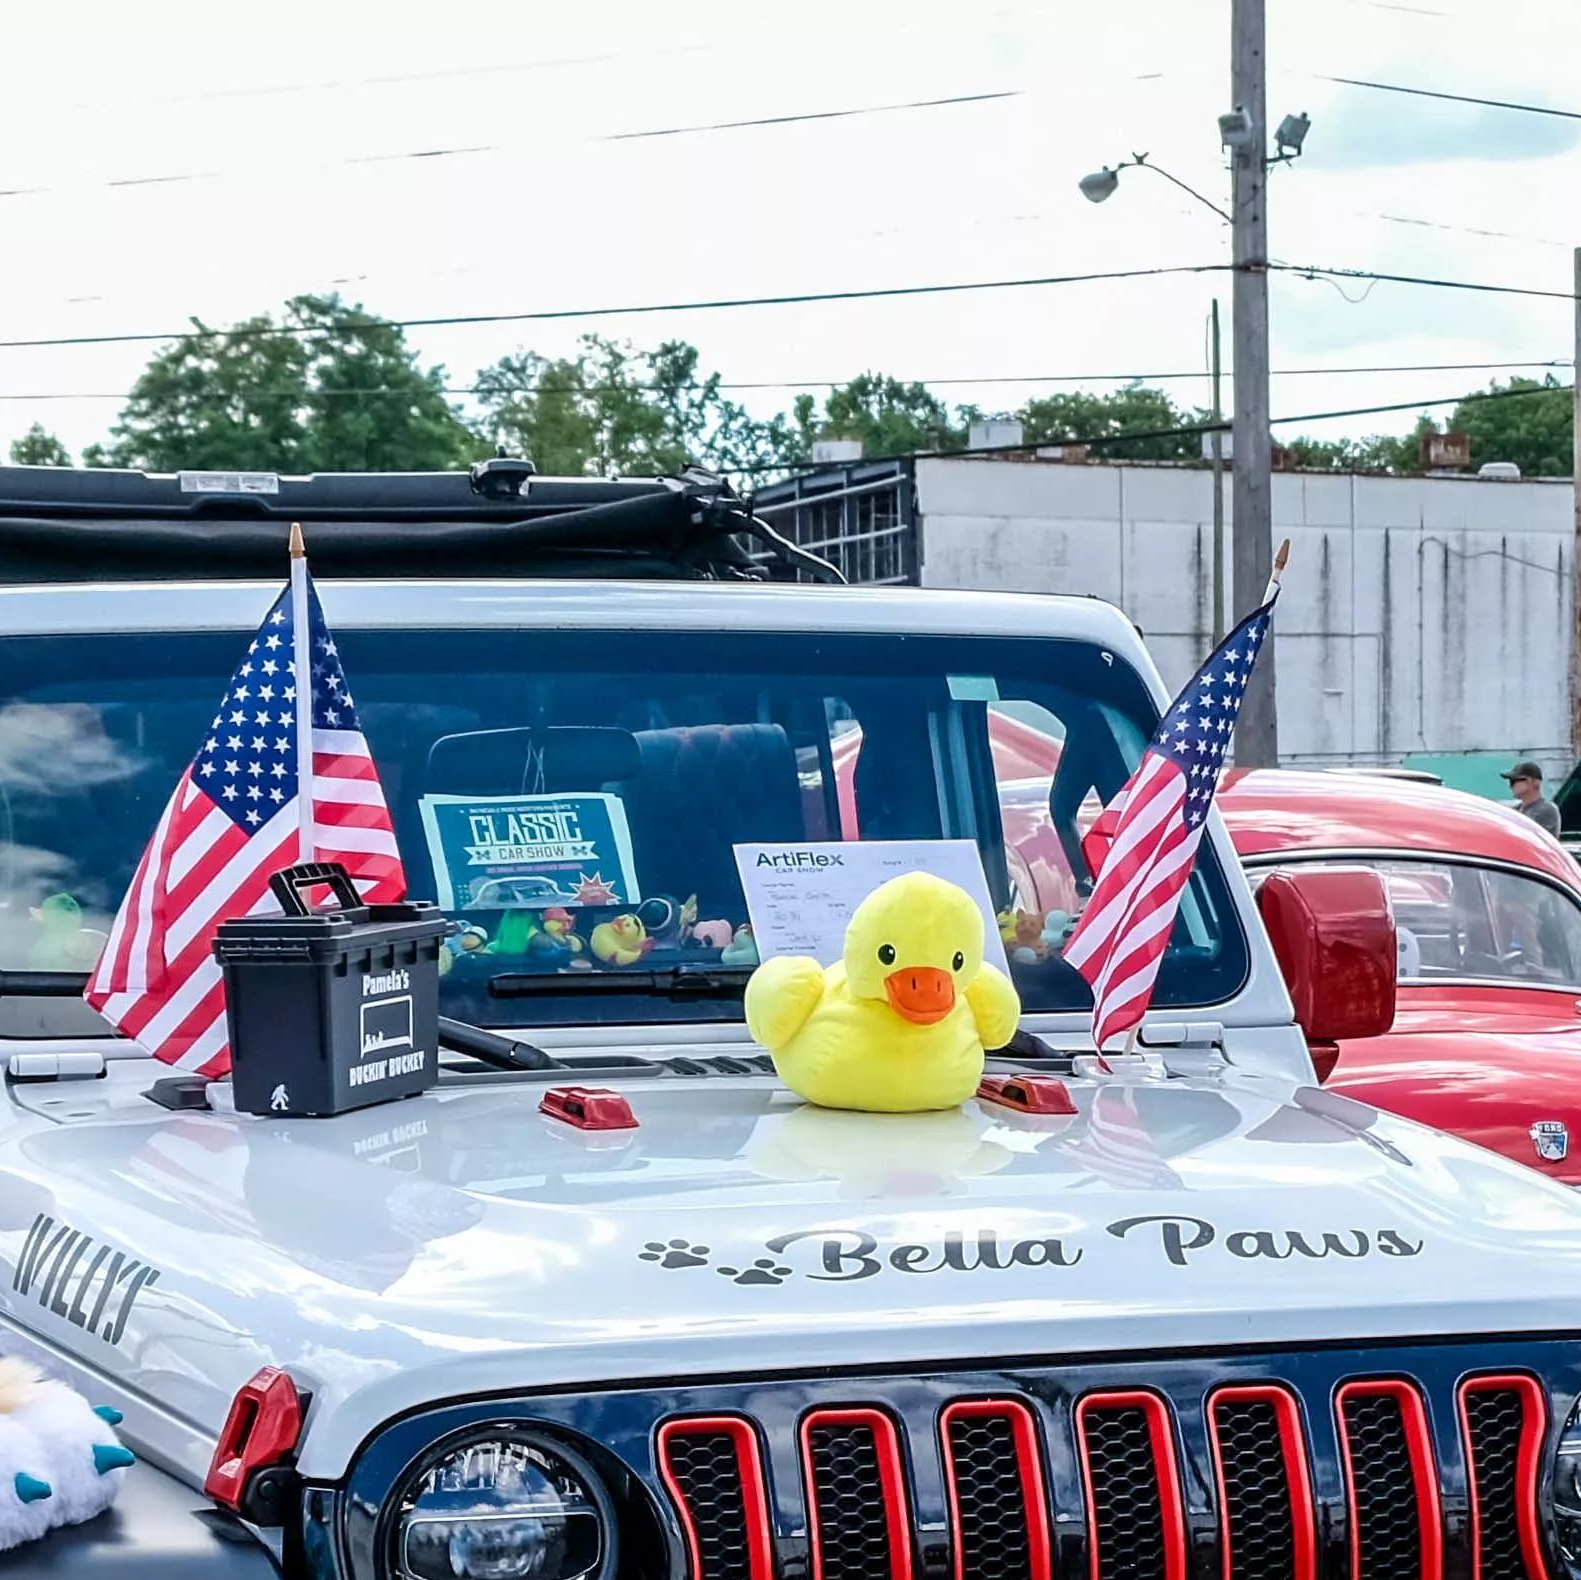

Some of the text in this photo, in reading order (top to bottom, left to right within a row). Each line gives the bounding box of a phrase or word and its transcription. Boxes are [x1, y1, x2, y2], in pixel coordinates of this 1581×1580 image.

[469, 812, 583, 846] CLASSIC
[499, 845, 565, 861] CAR SHOW
[756, 852, 844, 867] ArtiFlex
[362, 969, 410, 996] Pamela's
[766, 1215, 1424, 1281] Bella Paws
[12, 1213, 161, 1346] WILLYS
